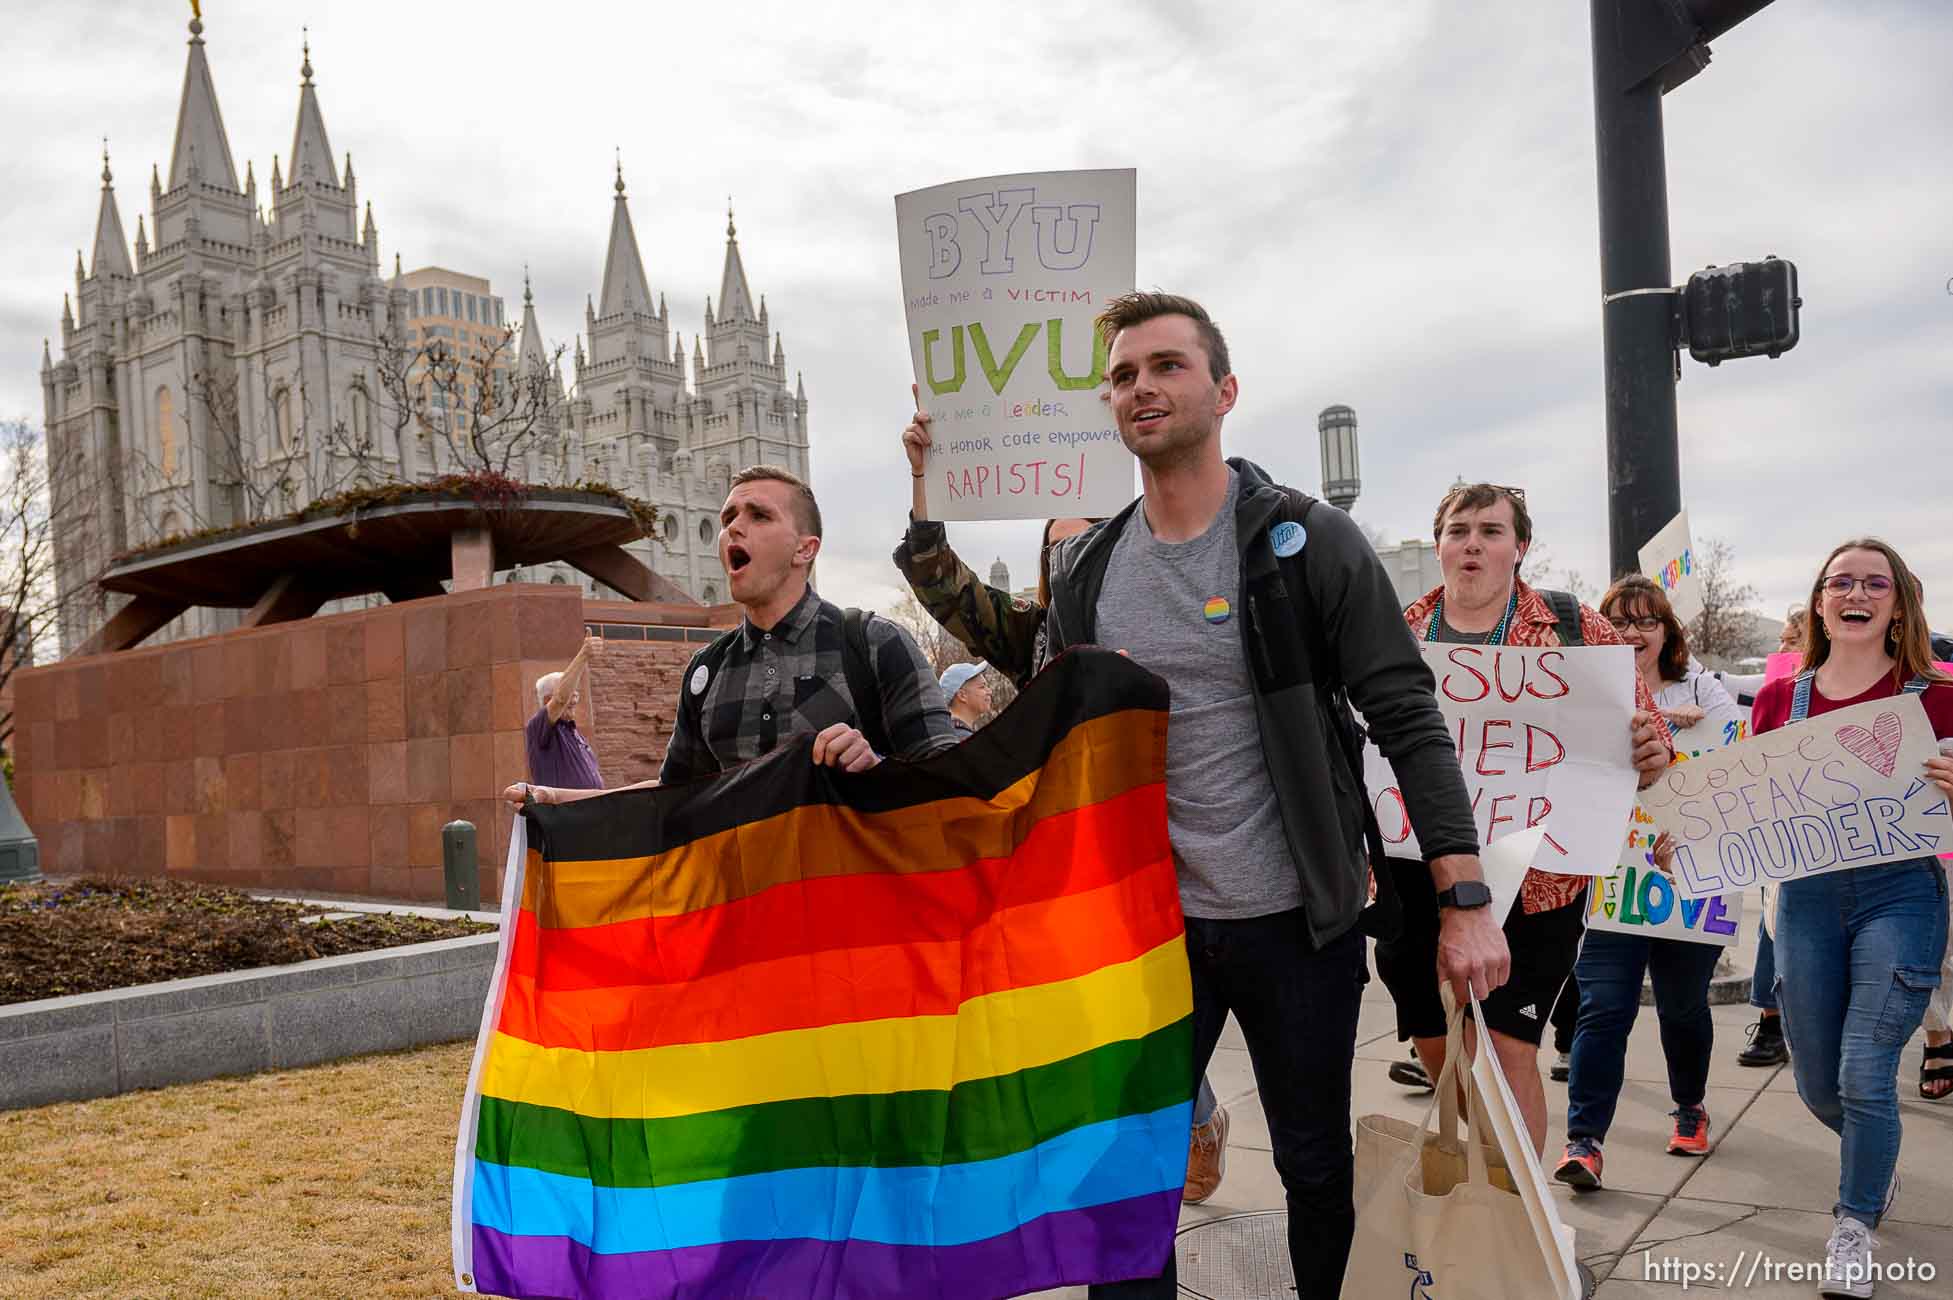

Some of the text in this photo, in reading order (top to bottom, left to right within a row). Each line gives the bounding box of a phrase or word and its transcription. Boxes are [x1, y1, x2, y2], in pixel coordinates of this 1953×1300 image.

[924, 187, 1100, 279] BYU
[1007, 288, 1092, 305] VICTIM
[922, 318, 1108, 395] UVU
[946, 452, 1086, 500] RAPISTS!
[1440, 646, 1570, 704] SUS
[1457, 717, 1566, 776] IED
[1679, 760, 1861, 841] SPEAKS
[1675, 797, 1921, 895] LOUDER
[1619, 866, 1738, 937] LOVE
